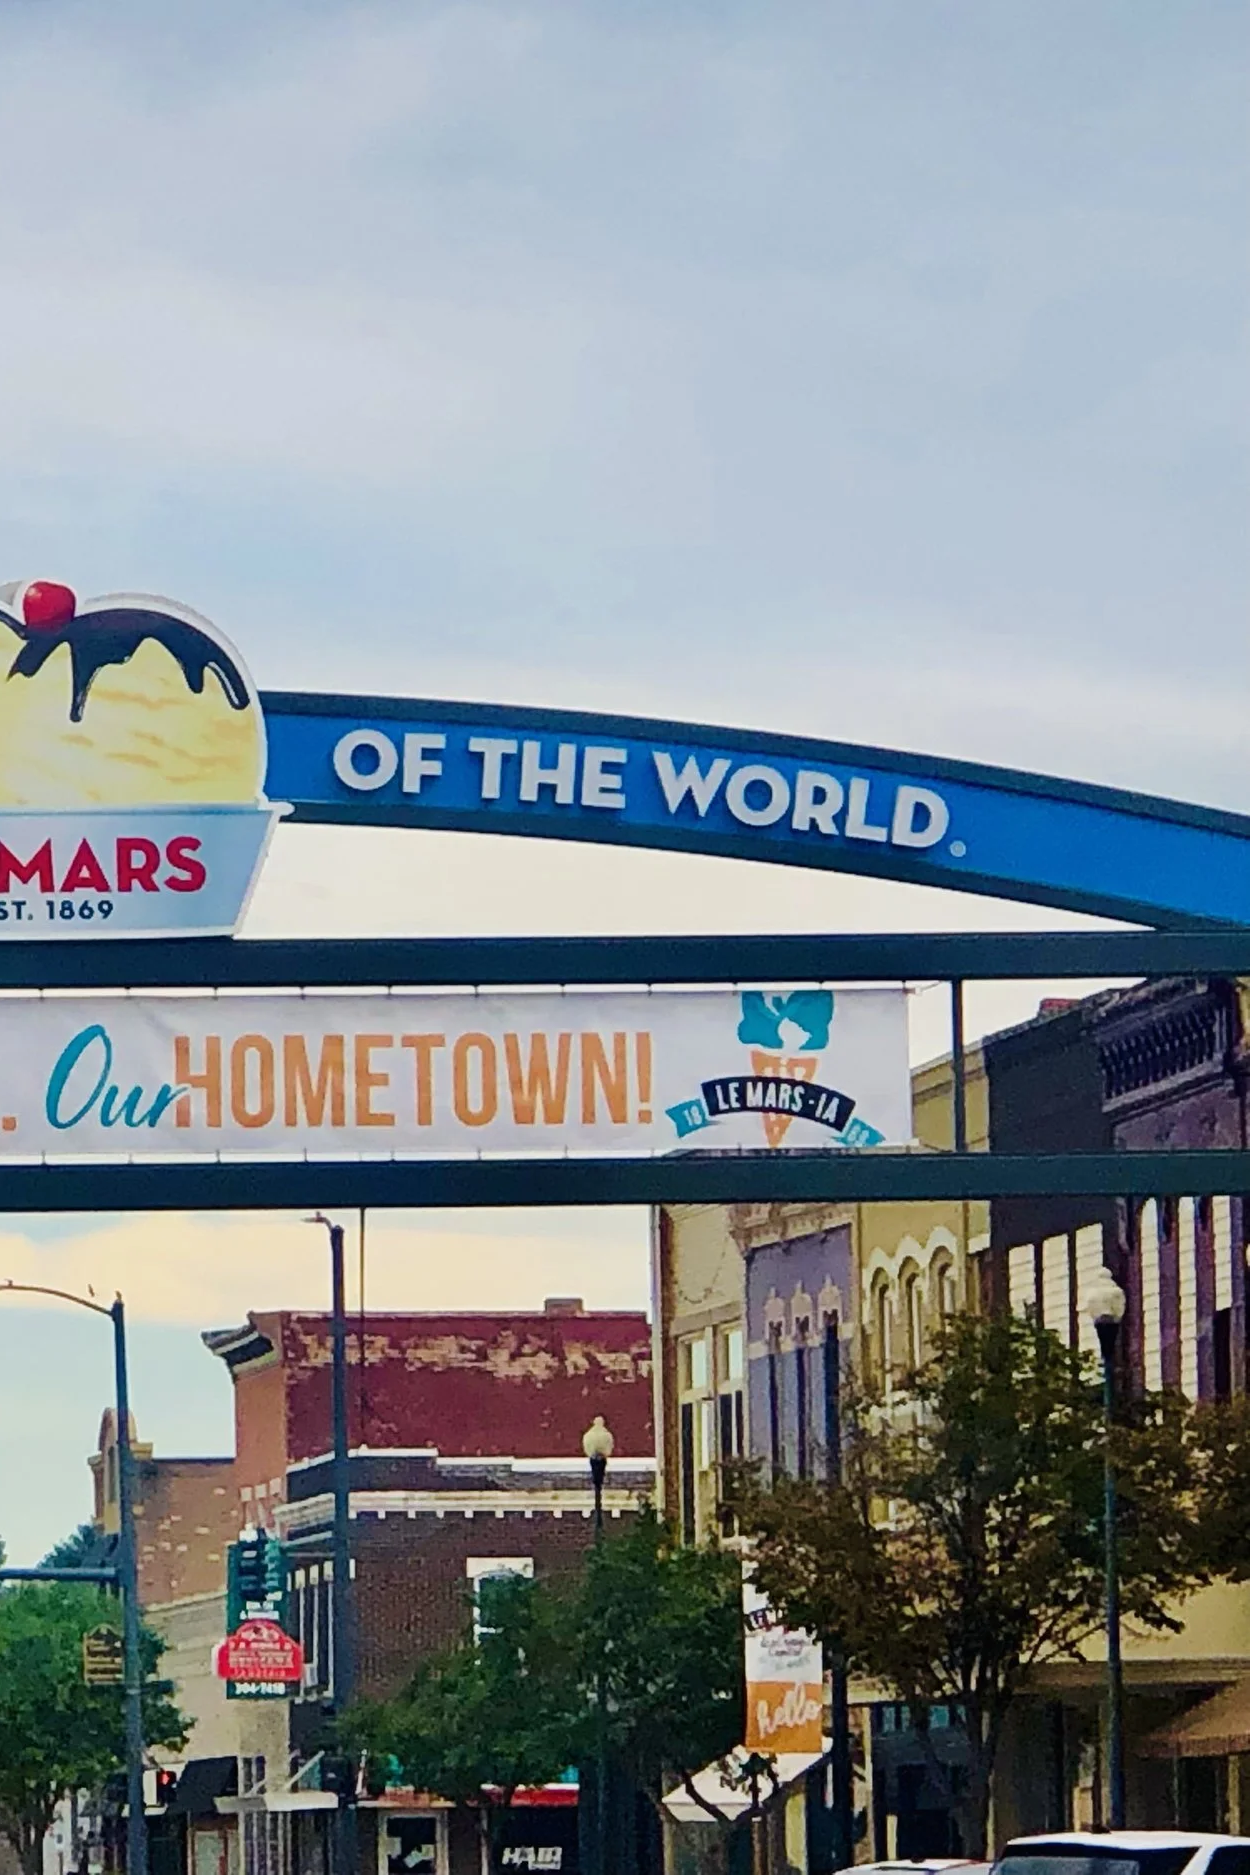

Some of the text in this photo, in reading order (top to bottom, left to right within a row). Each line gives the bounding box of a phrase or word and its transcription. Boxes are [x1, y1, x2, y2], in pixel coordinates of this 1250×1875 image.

[333, 728, 446, 794] OF
[468, 736, 627, 809] THE
[45, 899, 114, 921] 1869
[45, 1022, 190, 1131] Our
[174, 1031, 654, 1128] HOMETOWN!
[715, 1081, 741, 1111] LE
